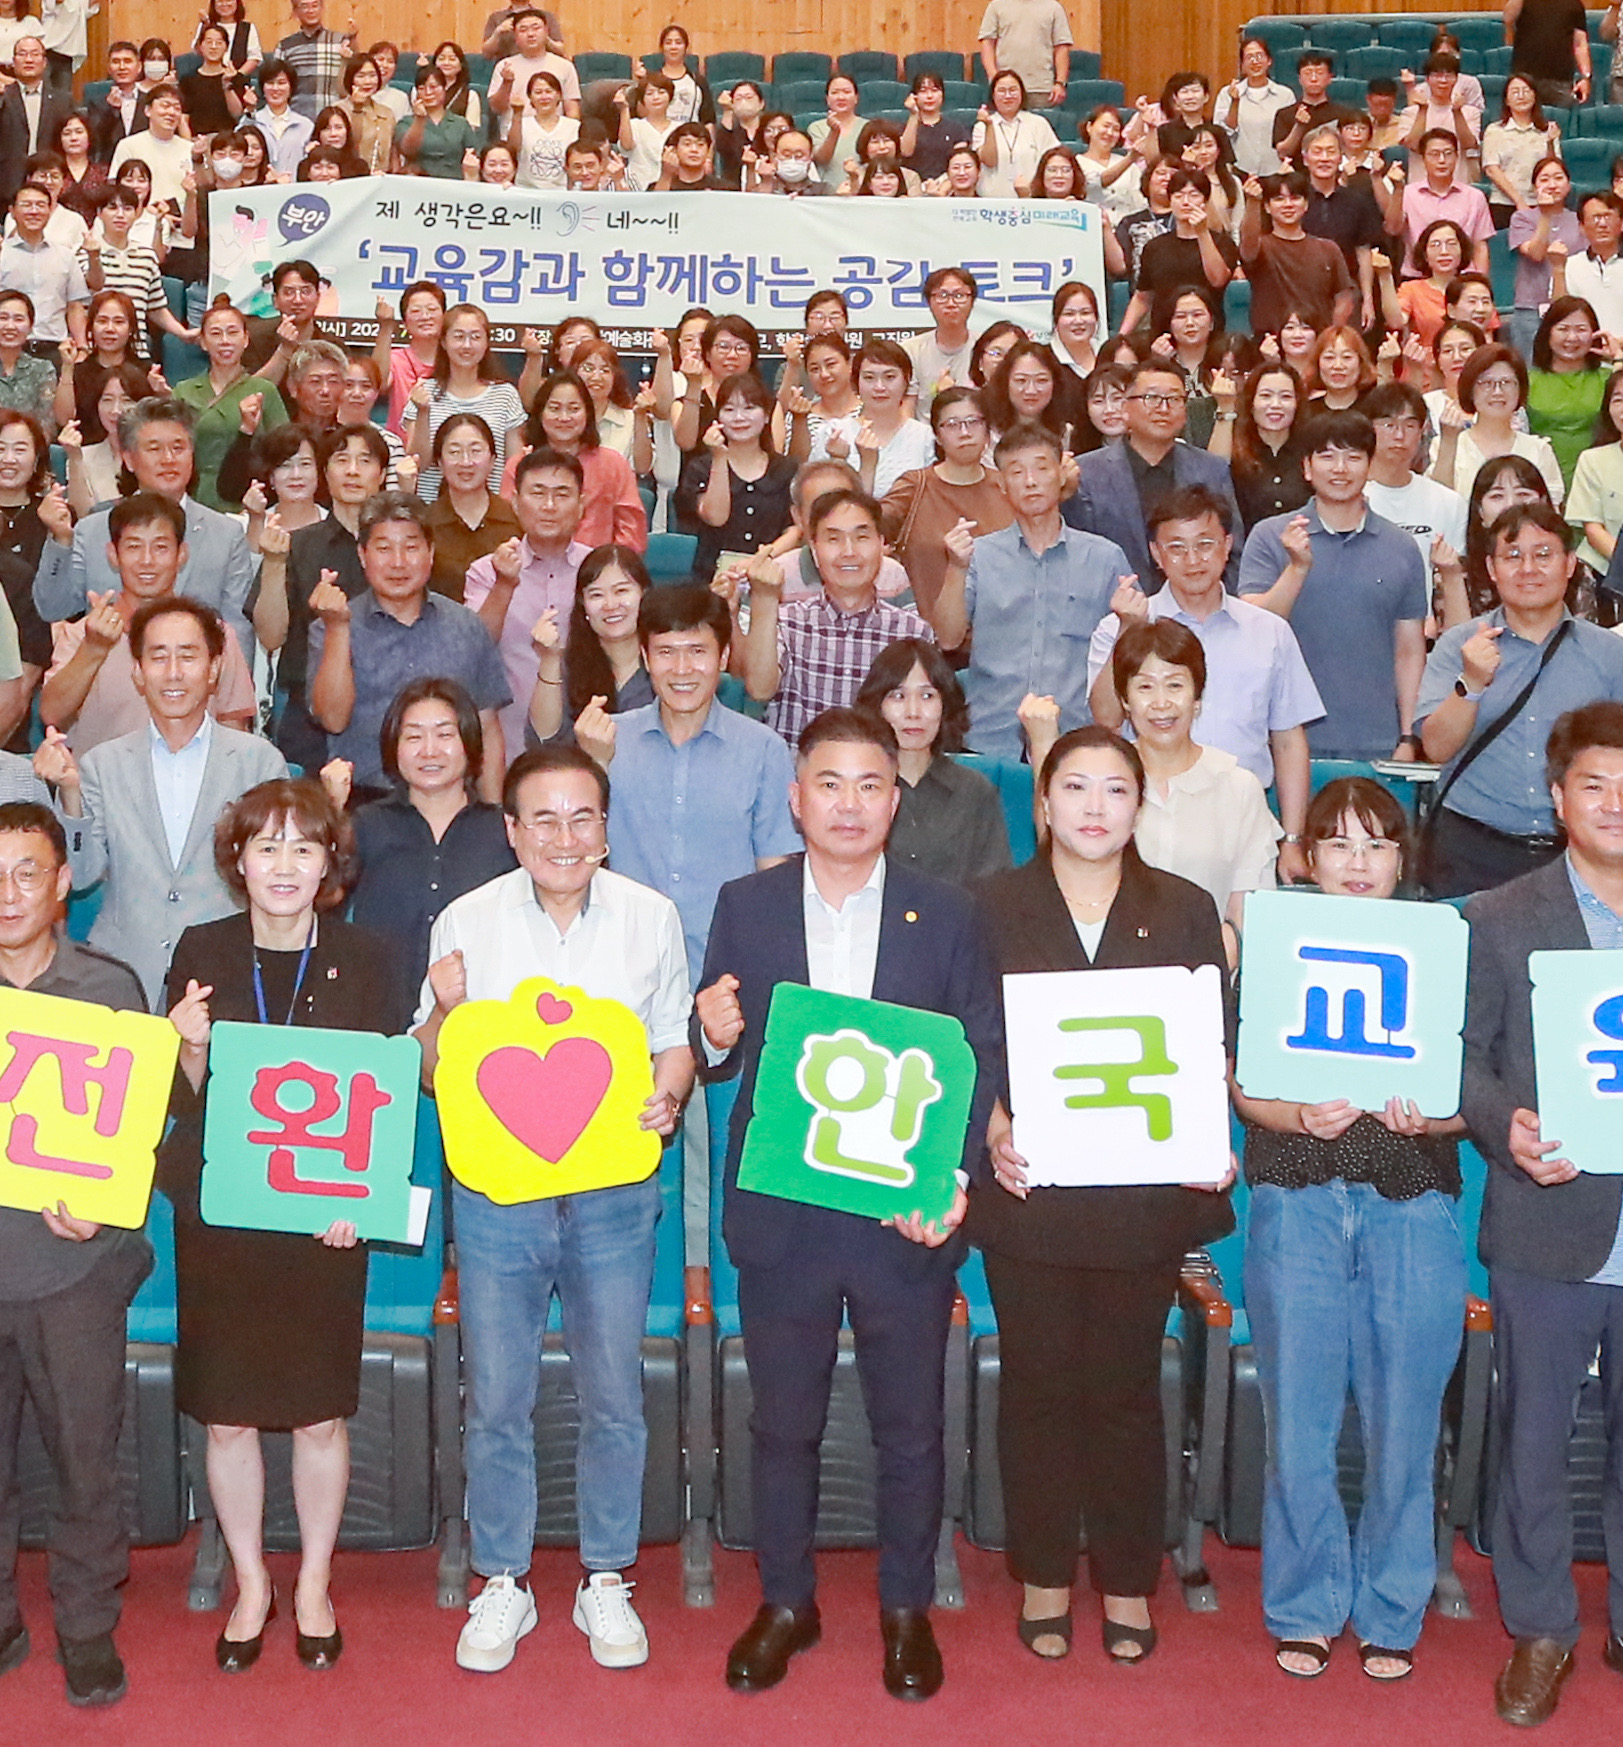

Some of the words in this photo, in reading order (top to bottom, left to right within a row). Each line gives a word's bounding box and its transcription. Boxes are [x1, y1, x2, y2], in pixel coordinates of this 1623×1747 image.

[281, 203, 326, 234] 부안
[376, 202, 399, 220] 제
[602, 249, 815, 308] 함께하는
[833, 255, 931, 309] 공감
[1286, 946, 1415, 1058] 교
[247, 1061, 392, 1198] 환
[803, 1036, 938, 1180] 한
[1052, 1015, 1179, 1142] 국
